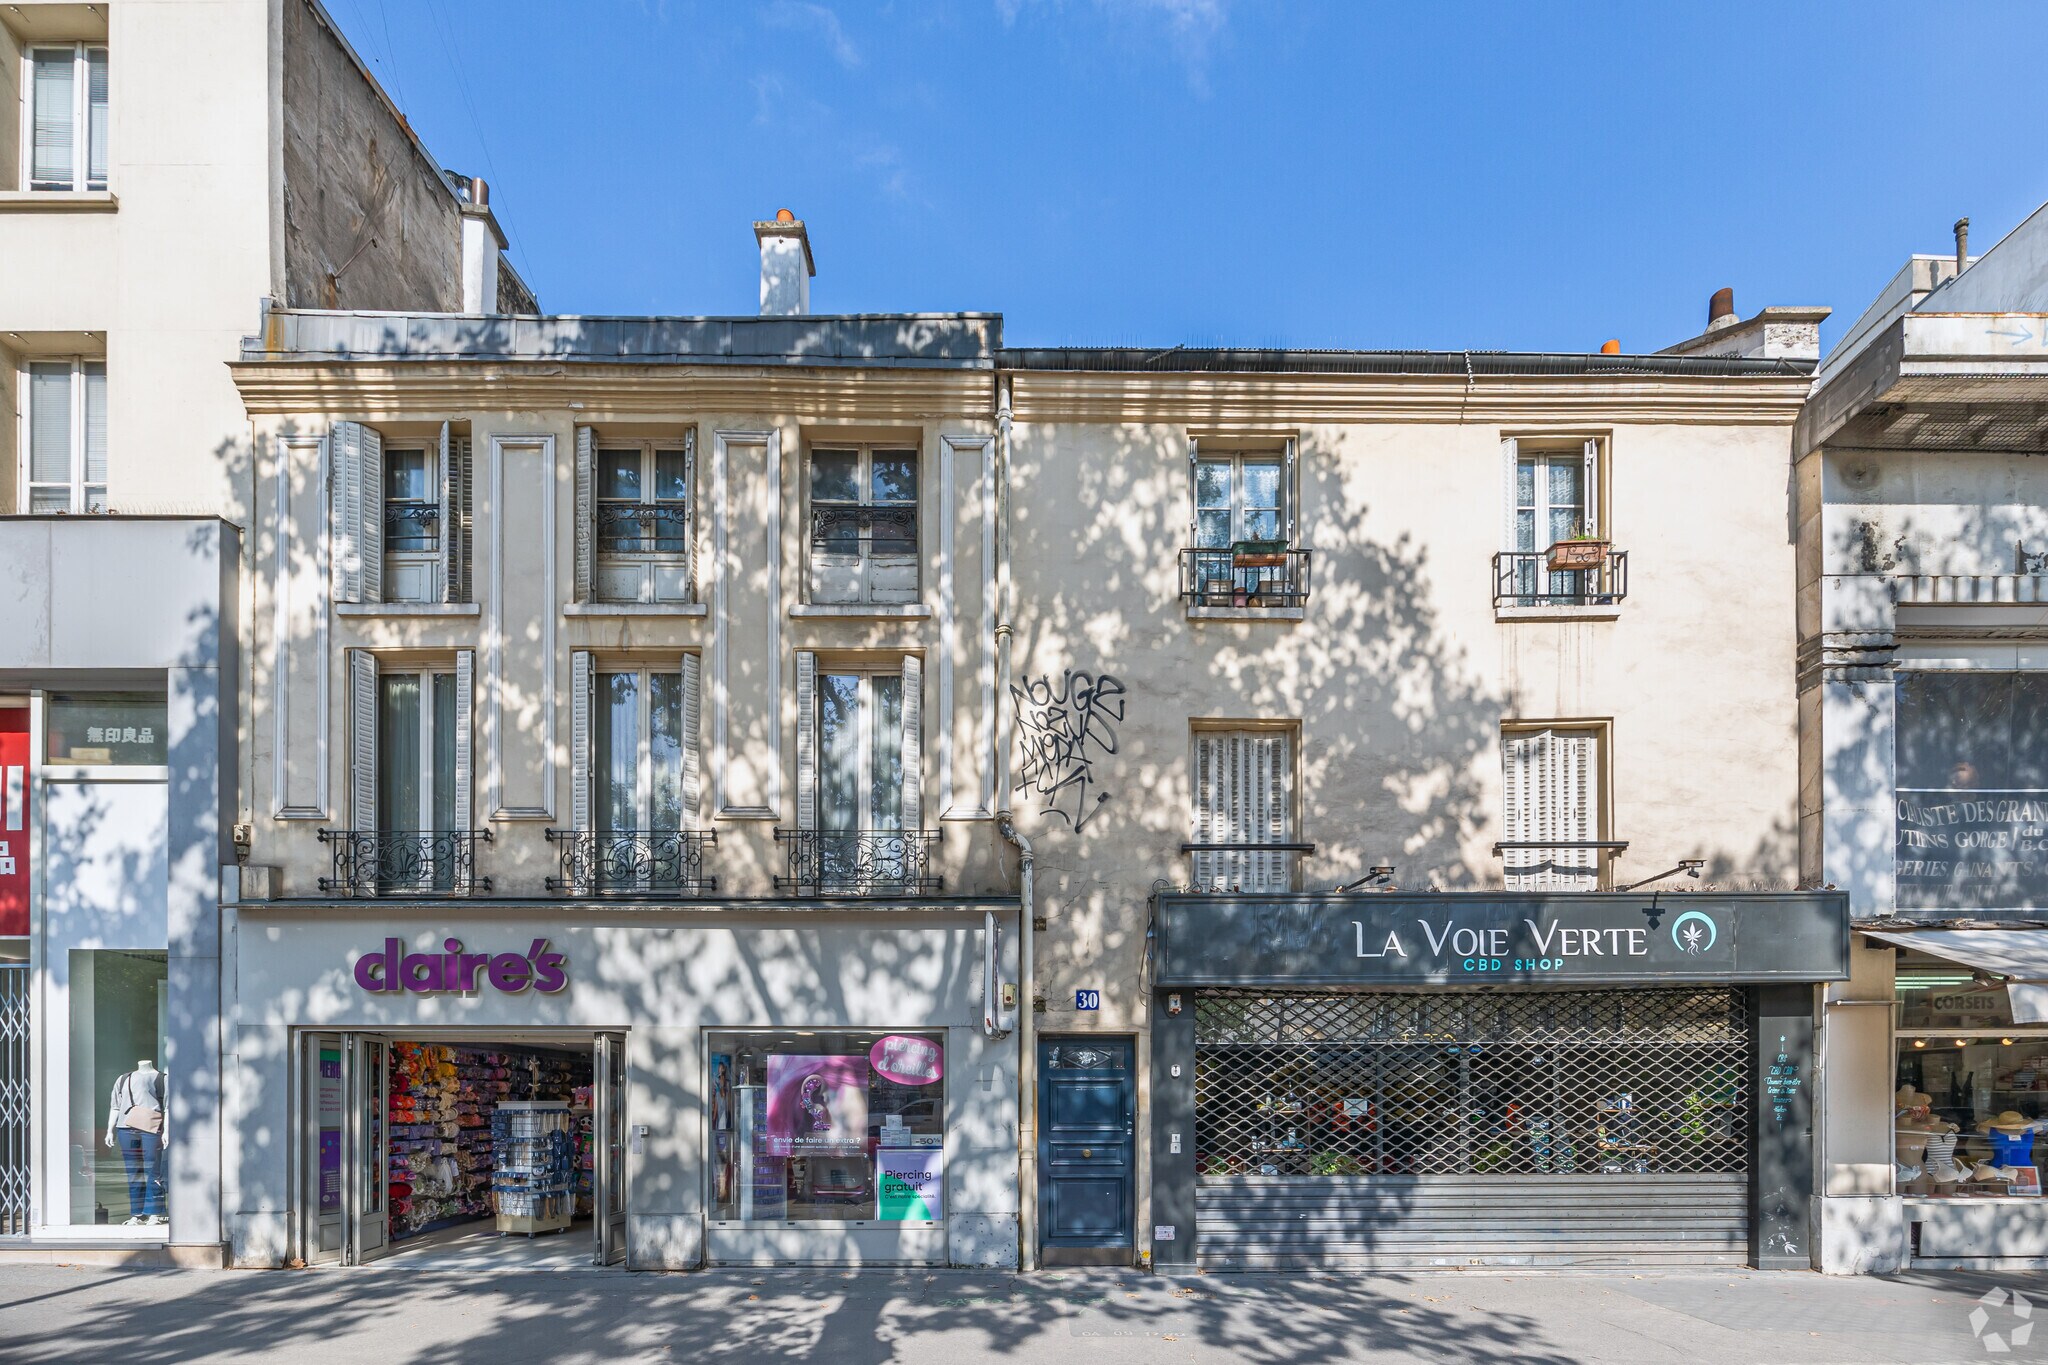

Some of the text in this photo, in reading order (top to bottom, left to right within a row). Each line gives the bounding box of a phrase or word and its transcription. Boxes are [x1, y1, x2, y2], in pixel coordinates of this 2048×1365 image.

[87, 726, 154, 743] 無印良品
[1896, 799, 1960, 827] CIALISTE
[1961, 800, 1994, 823] DES
[1954, 831, 2008, 849] GORGE
[1523, 918, 1648, 957] VERTE
[354, 937, 568, 992] claire's
[1463, 958, 1565, 972] CBD SHOP
[1078, 992, 1098, 1009] 30
[1933, 995, 1996, 1010] CORSETS
[884, 1038, 938, 1063] piercing
[884, 1169, 932, 1181] Piercing
